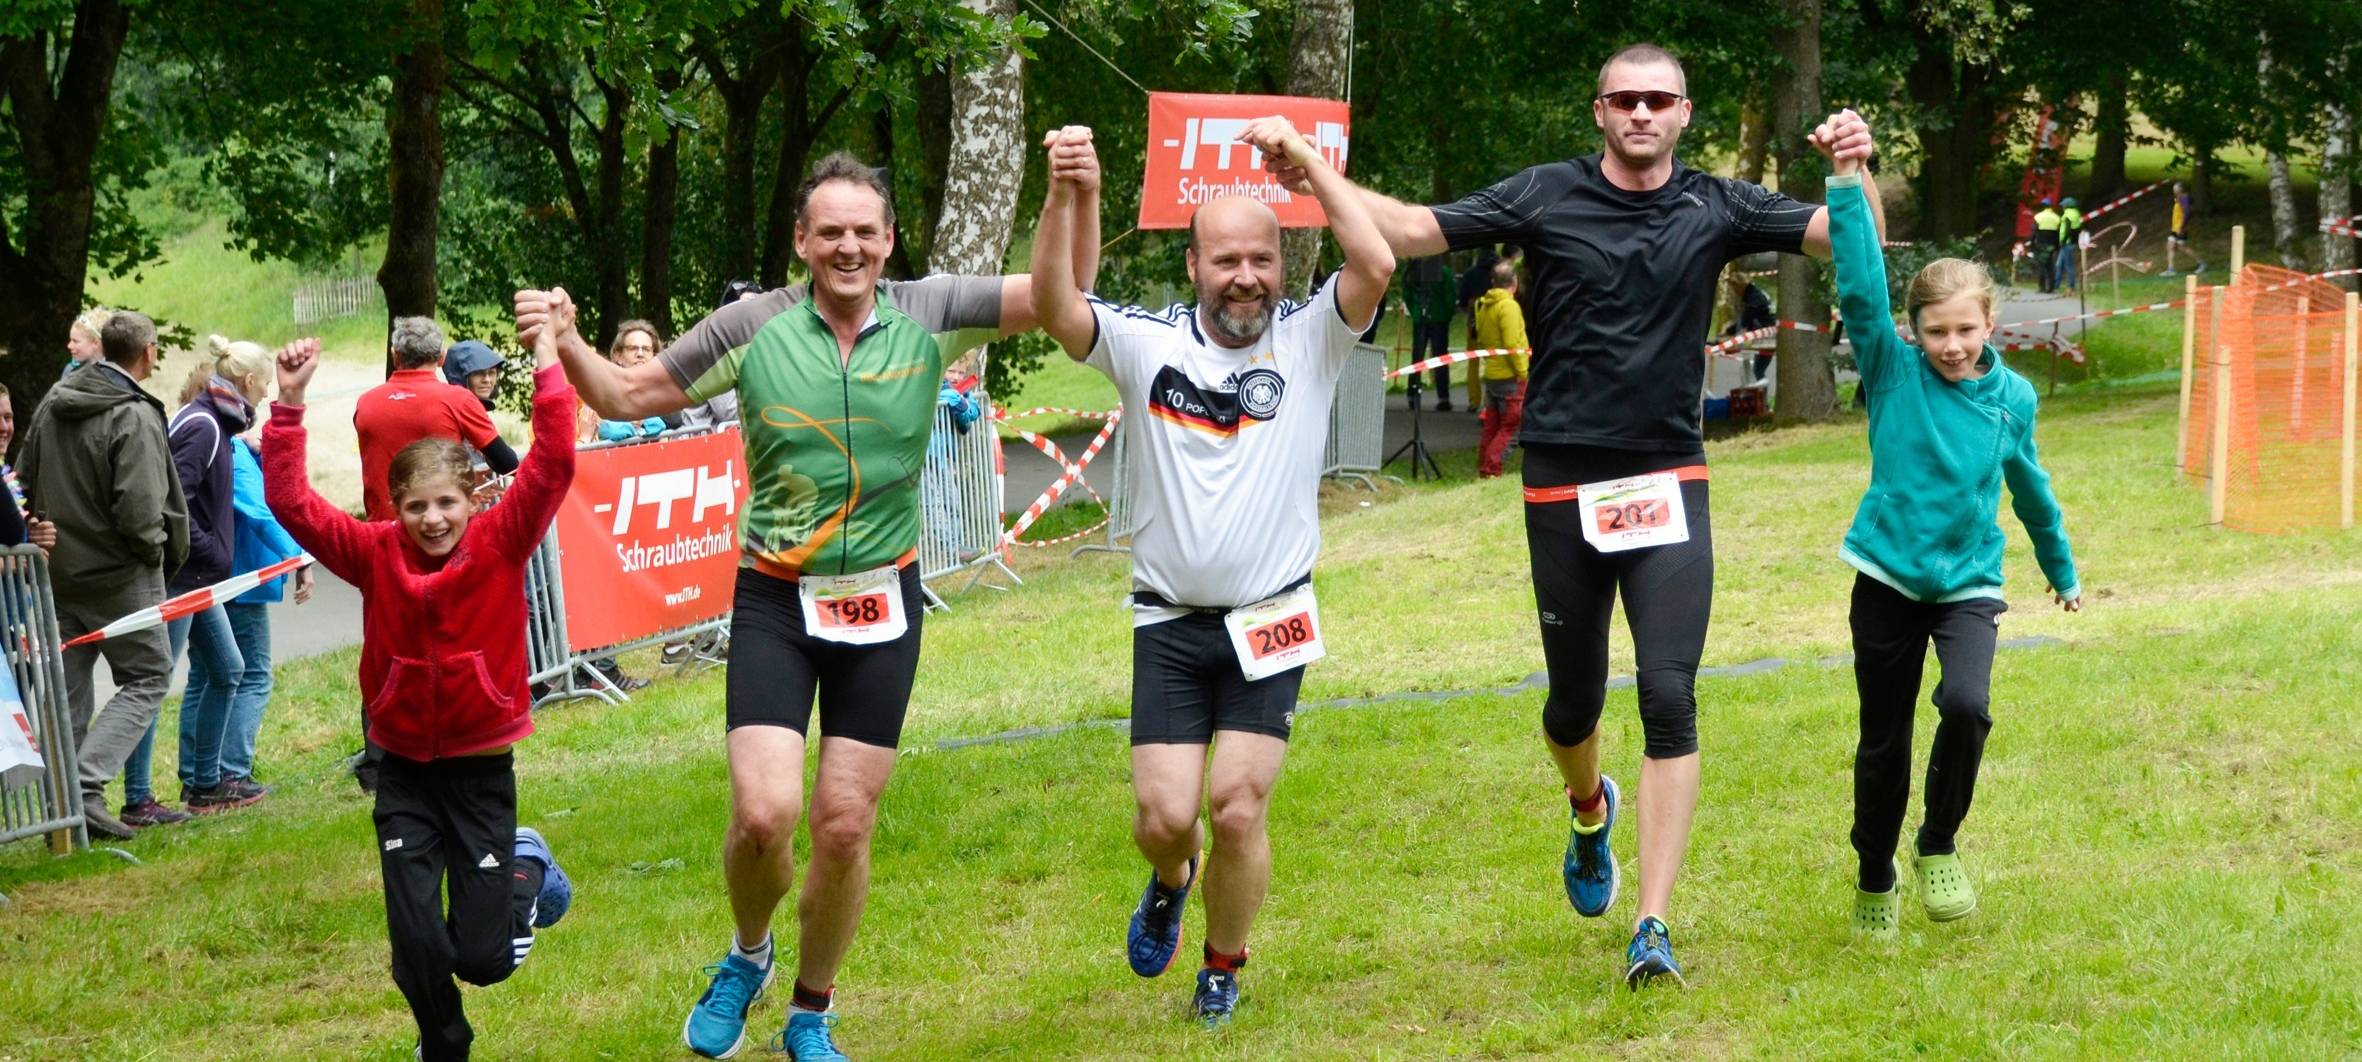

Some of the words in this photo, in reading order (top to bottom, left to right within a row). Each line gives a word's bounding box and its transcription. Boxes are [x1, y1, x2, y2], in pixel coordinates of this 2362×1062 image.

[1165, 387, 1184, 408] 10
[616, 524, 732, 573] Schraubtechnik
[827, 597, 880, 625] 198
[1256, 618, 1306, 654] 208
